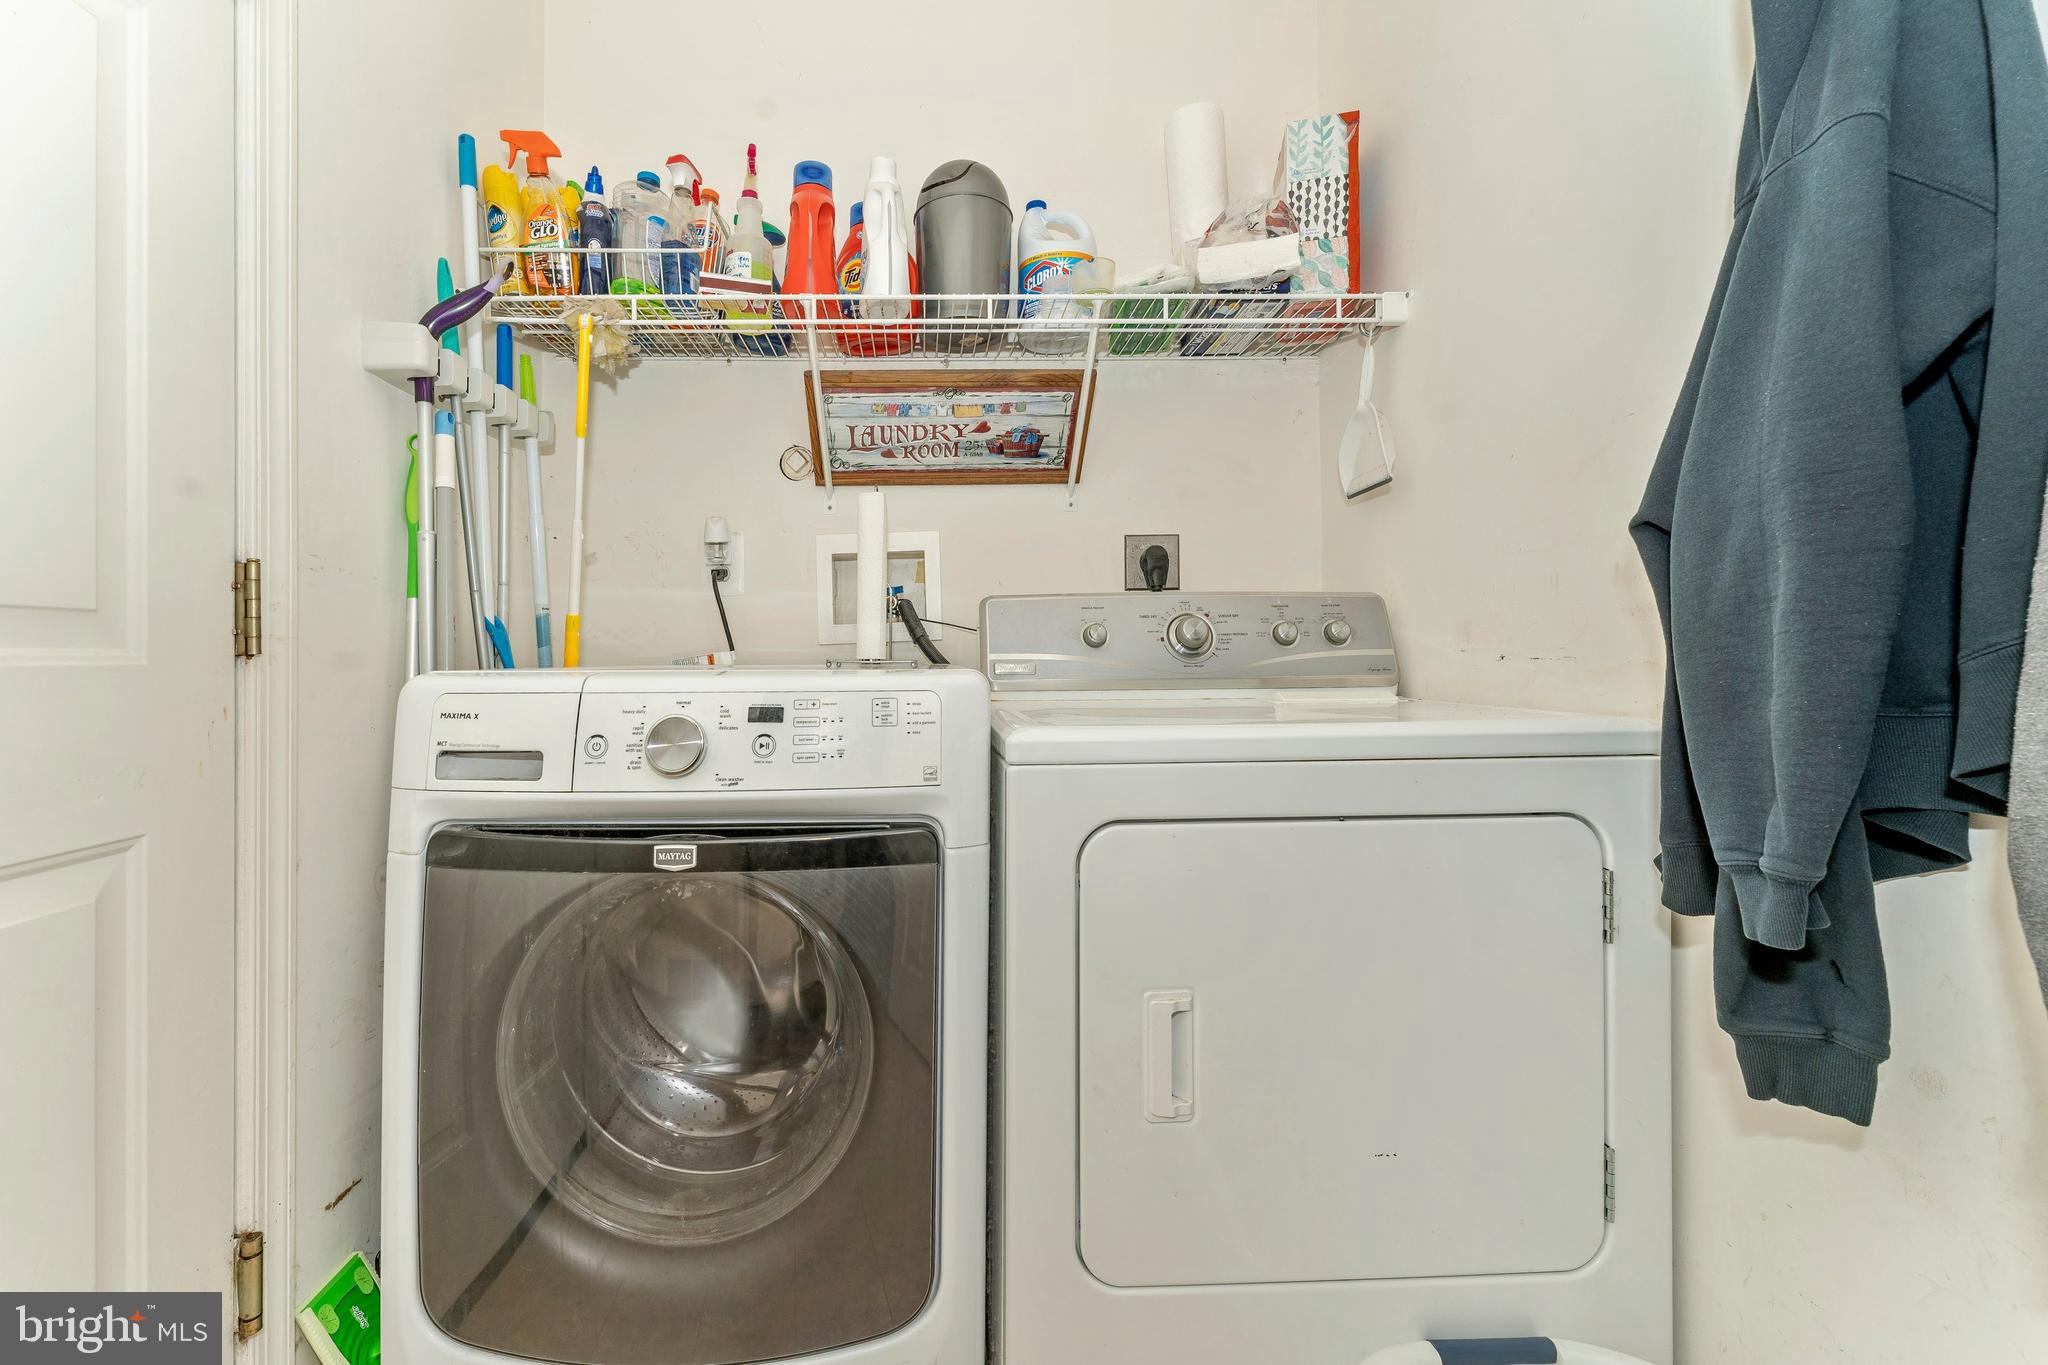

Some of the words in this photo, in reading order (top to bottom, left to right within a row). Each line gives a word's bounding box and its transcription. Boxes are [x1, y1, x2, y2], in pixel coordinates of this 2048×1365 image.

[528, 218, 554, 229] Orange
[530, 224, 558, 240] GLO
[844, 267, 861, 287] Tid
[1027, 264, 1064, 291] CLOROX
[846, 423, 970, 452] LAUNDRY
[900, 441, 961, 463] ROOM
[440, 712, 471, 720] MAXIMA
[473, 712, 480, 720] X
[658, 852, 692, 860] MAYTAG
